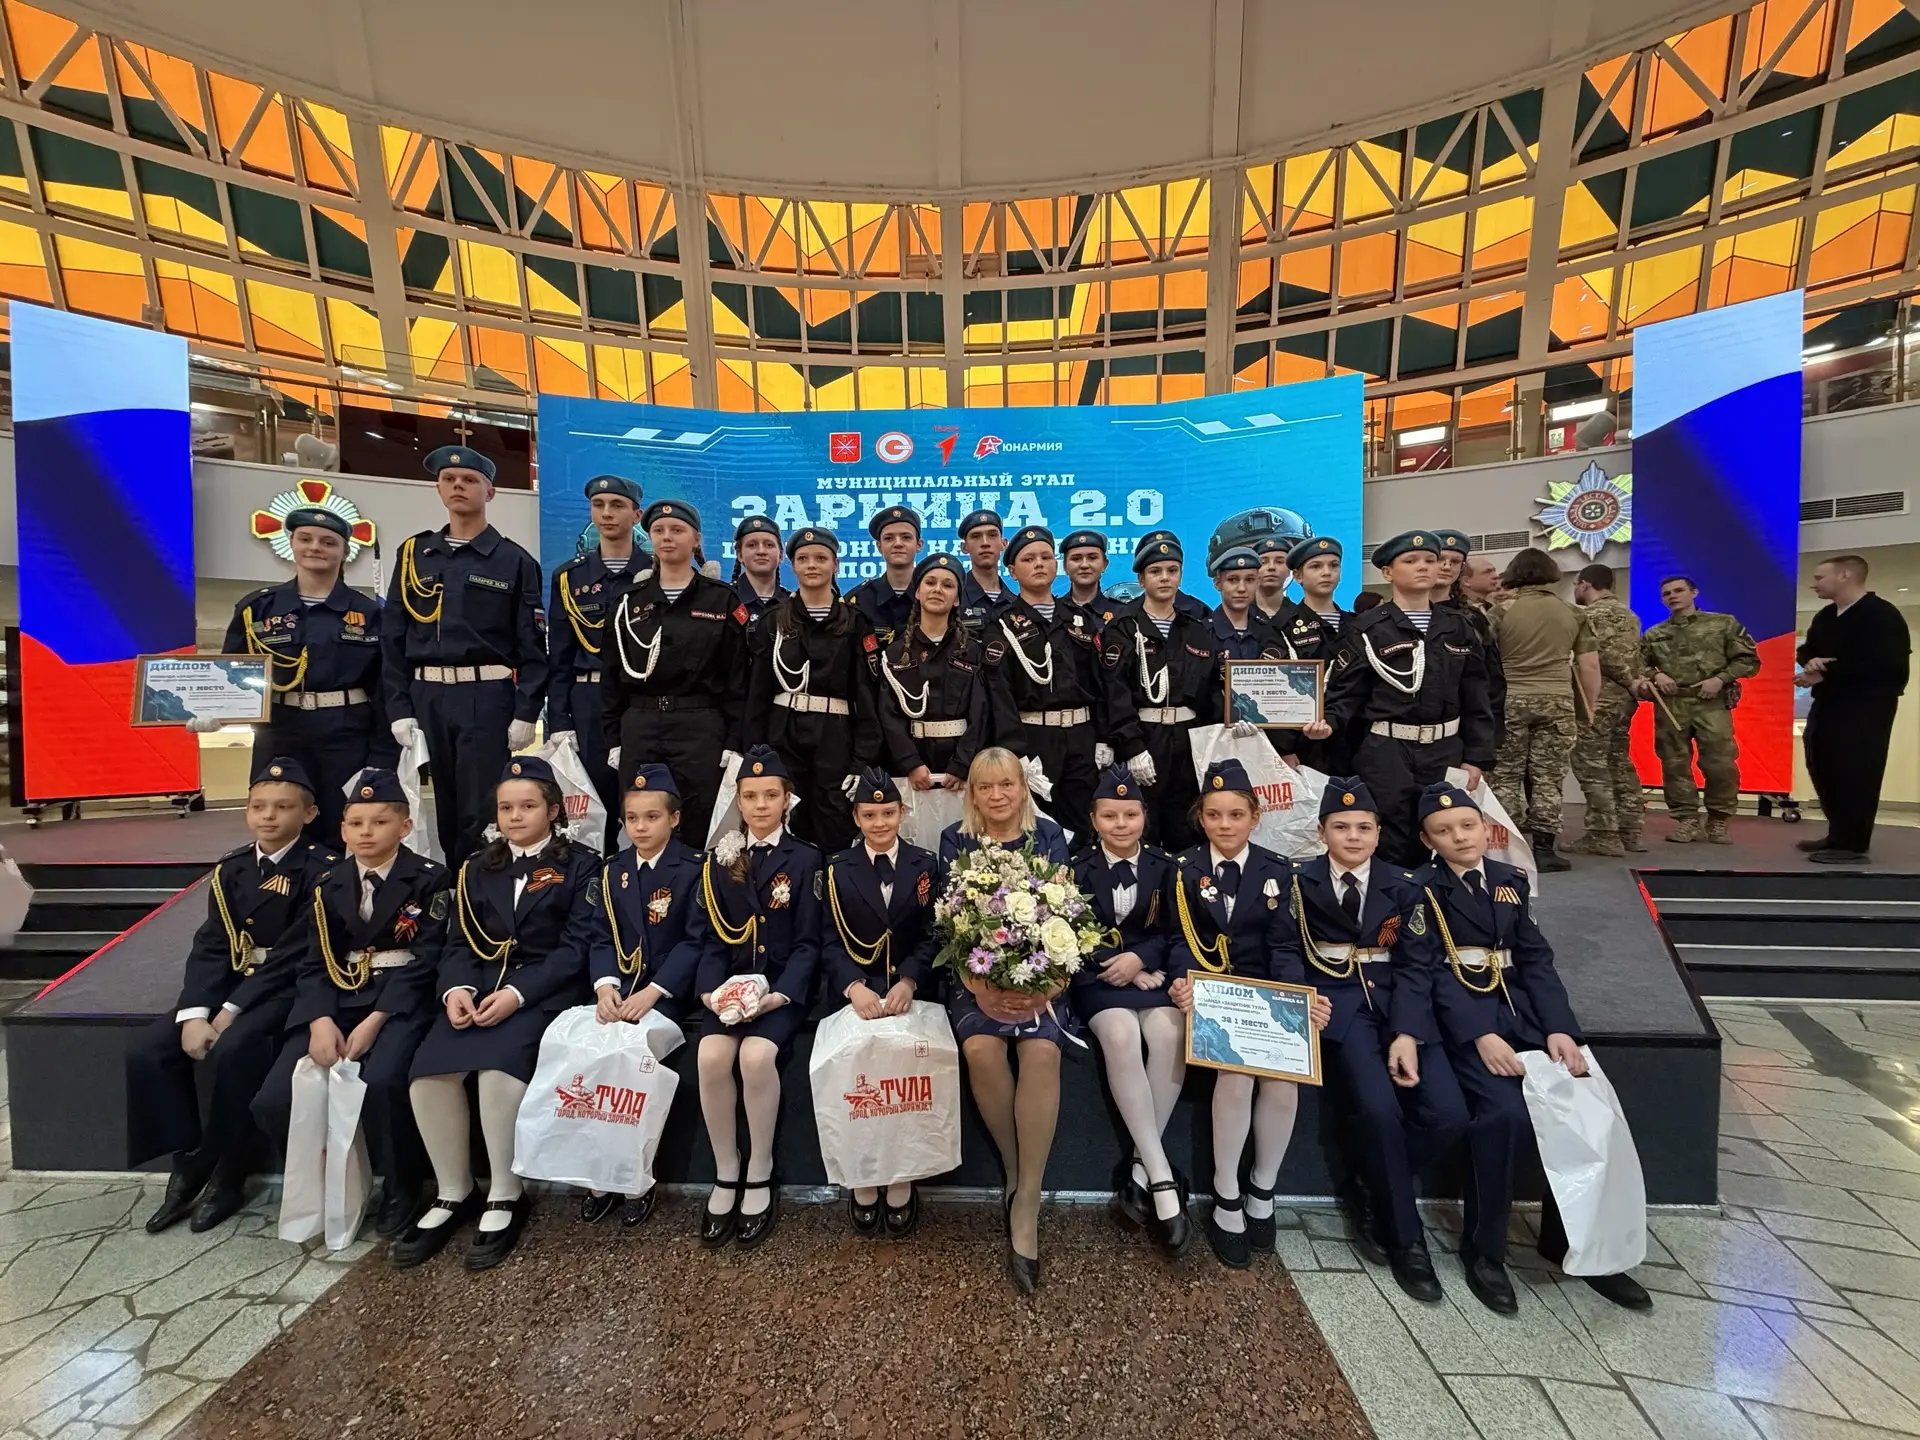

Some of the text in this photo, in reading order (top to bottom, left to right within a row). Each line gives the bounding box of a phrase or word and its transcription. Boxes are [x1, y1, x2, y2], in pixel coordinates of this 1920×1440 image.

[1002, 442, 1063, 452] ЮНАРМИЯ
[816, 473, 1075, 491] МУНИЦИПАЛЬНЫЙ ЭТАП
[1070, 488, 1164, 527] 2.0
[150, 663, 211, 672] ДИПЛОМ
[1233, 667, 1277, 676] ДИПЛОМ
[880, 1075, 932, 1105] ТУЛА
[595, 1084, 648, 1119] ТУЛА
